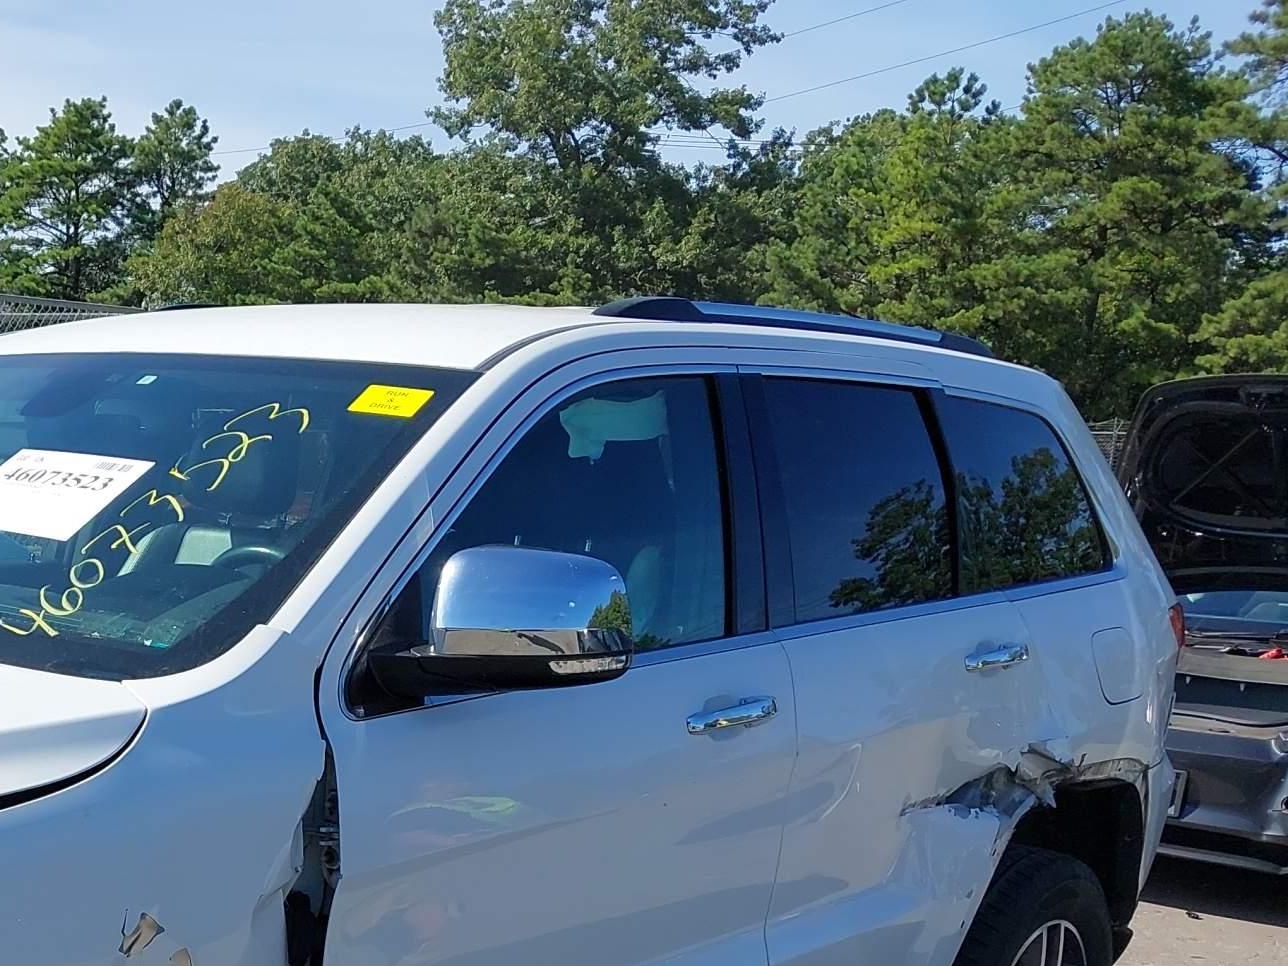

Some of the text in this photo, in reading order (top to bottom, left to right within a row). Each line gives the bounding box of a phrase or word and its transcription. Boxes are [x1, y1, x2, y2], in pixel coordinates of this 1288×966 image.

[386, 390, 410, 398] RUN
[369, 402, 401, 411] DRIVE
[3, 467, 115, 491] 46073523
